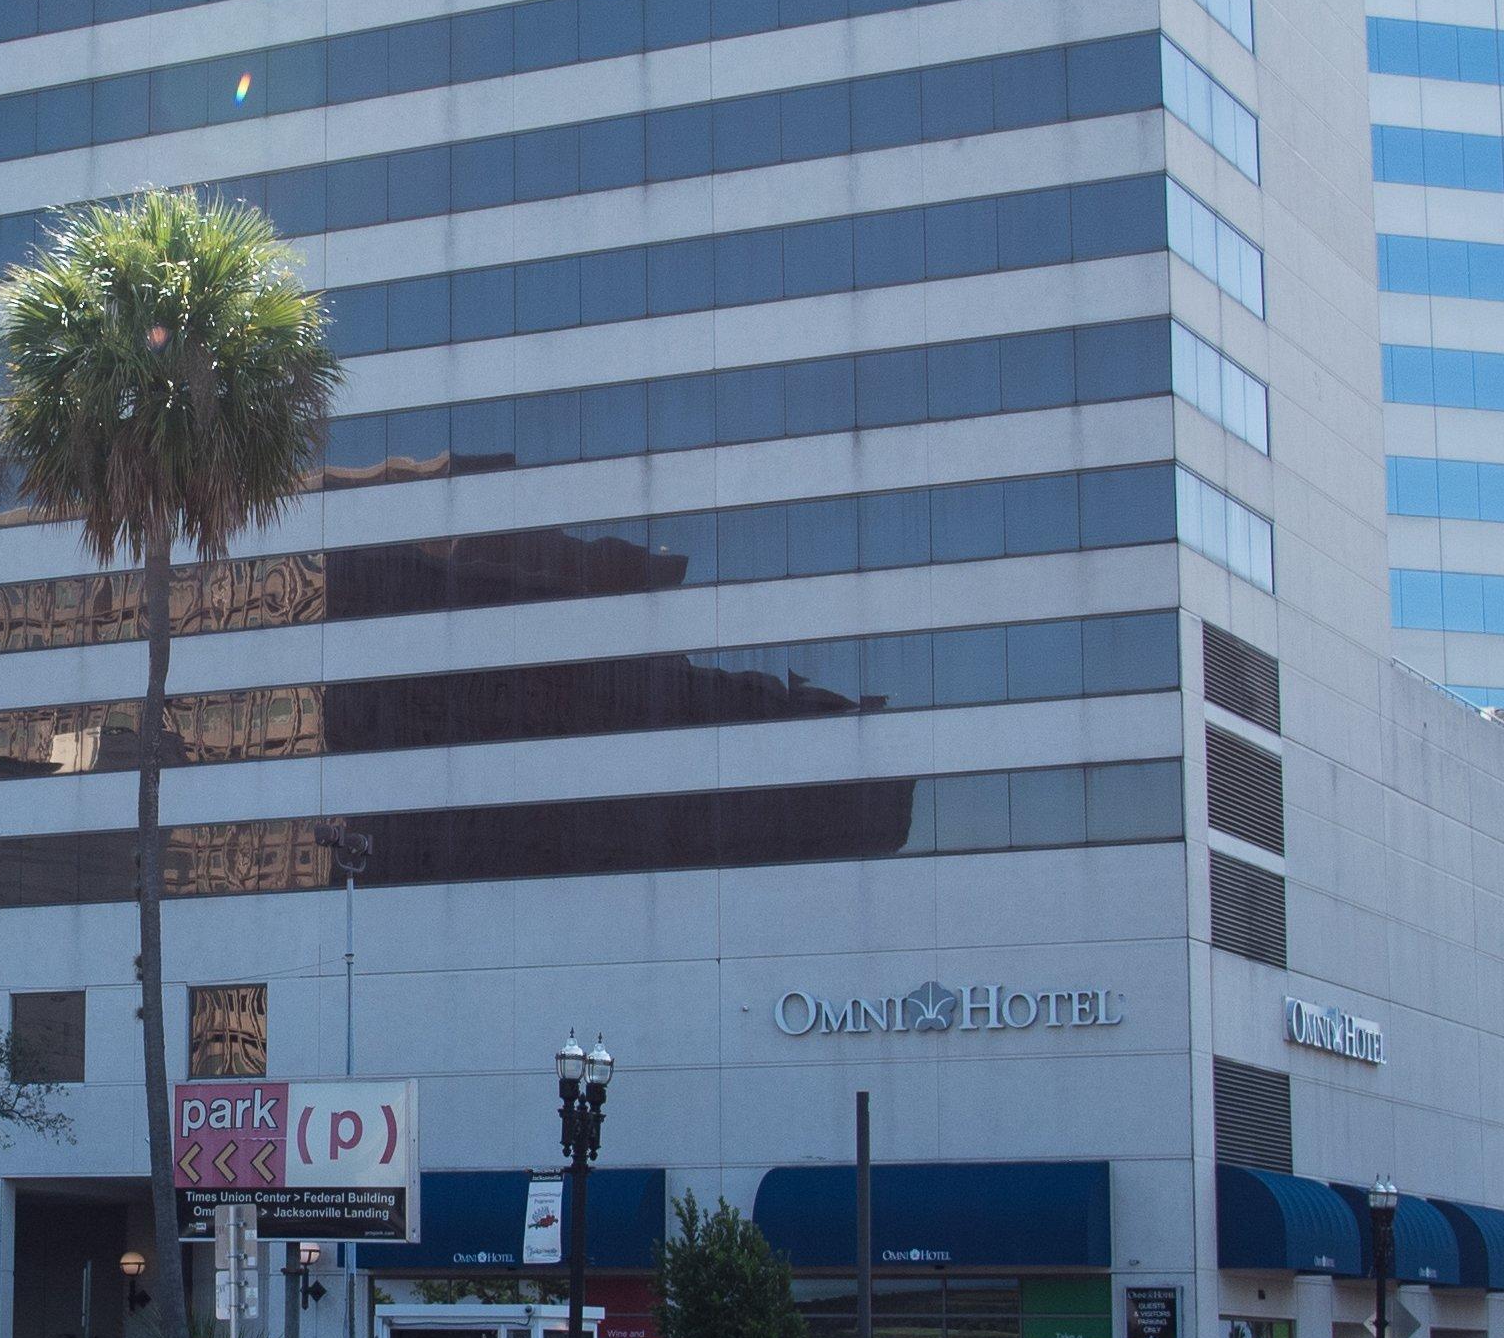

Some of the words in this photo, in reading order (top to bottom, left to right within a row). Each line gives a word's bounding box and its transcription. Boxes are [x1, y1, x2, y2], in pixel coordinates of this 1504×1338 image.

[774, 991, 910, 1035] OMNI
[958, 982, 1124, 1030] HOTEL
[1292, 1000, 1332, 1049] OMNI
[1341, 1013, 1387, 1064] HOTEL
[181, 1089, 279, 1139] park
[185, 1191, 217, 1202] Times
[220, 1191, 252, 1202] Union
[255, 1191, 291, 1203] Center
[304, 1192, 345, 1203] Federal
[348, 1192, 395, 1206] Building
[273, 1207, 342, 1218] Jacksonville
[344, 1208, 390, 1221] Landing
[453, 1252, 477, 1263] OMNI
[487, 1252, 515, 1263] HOTEL
[882, 1249, 909, 1261] OMNI
[921, 1249, 952, 1261] HOTEL
[1138, 1302, 1165, 1310] GUESTS
[607, 1330, 628, 1338] Wine
[629, 1330, 645, 1338] and
